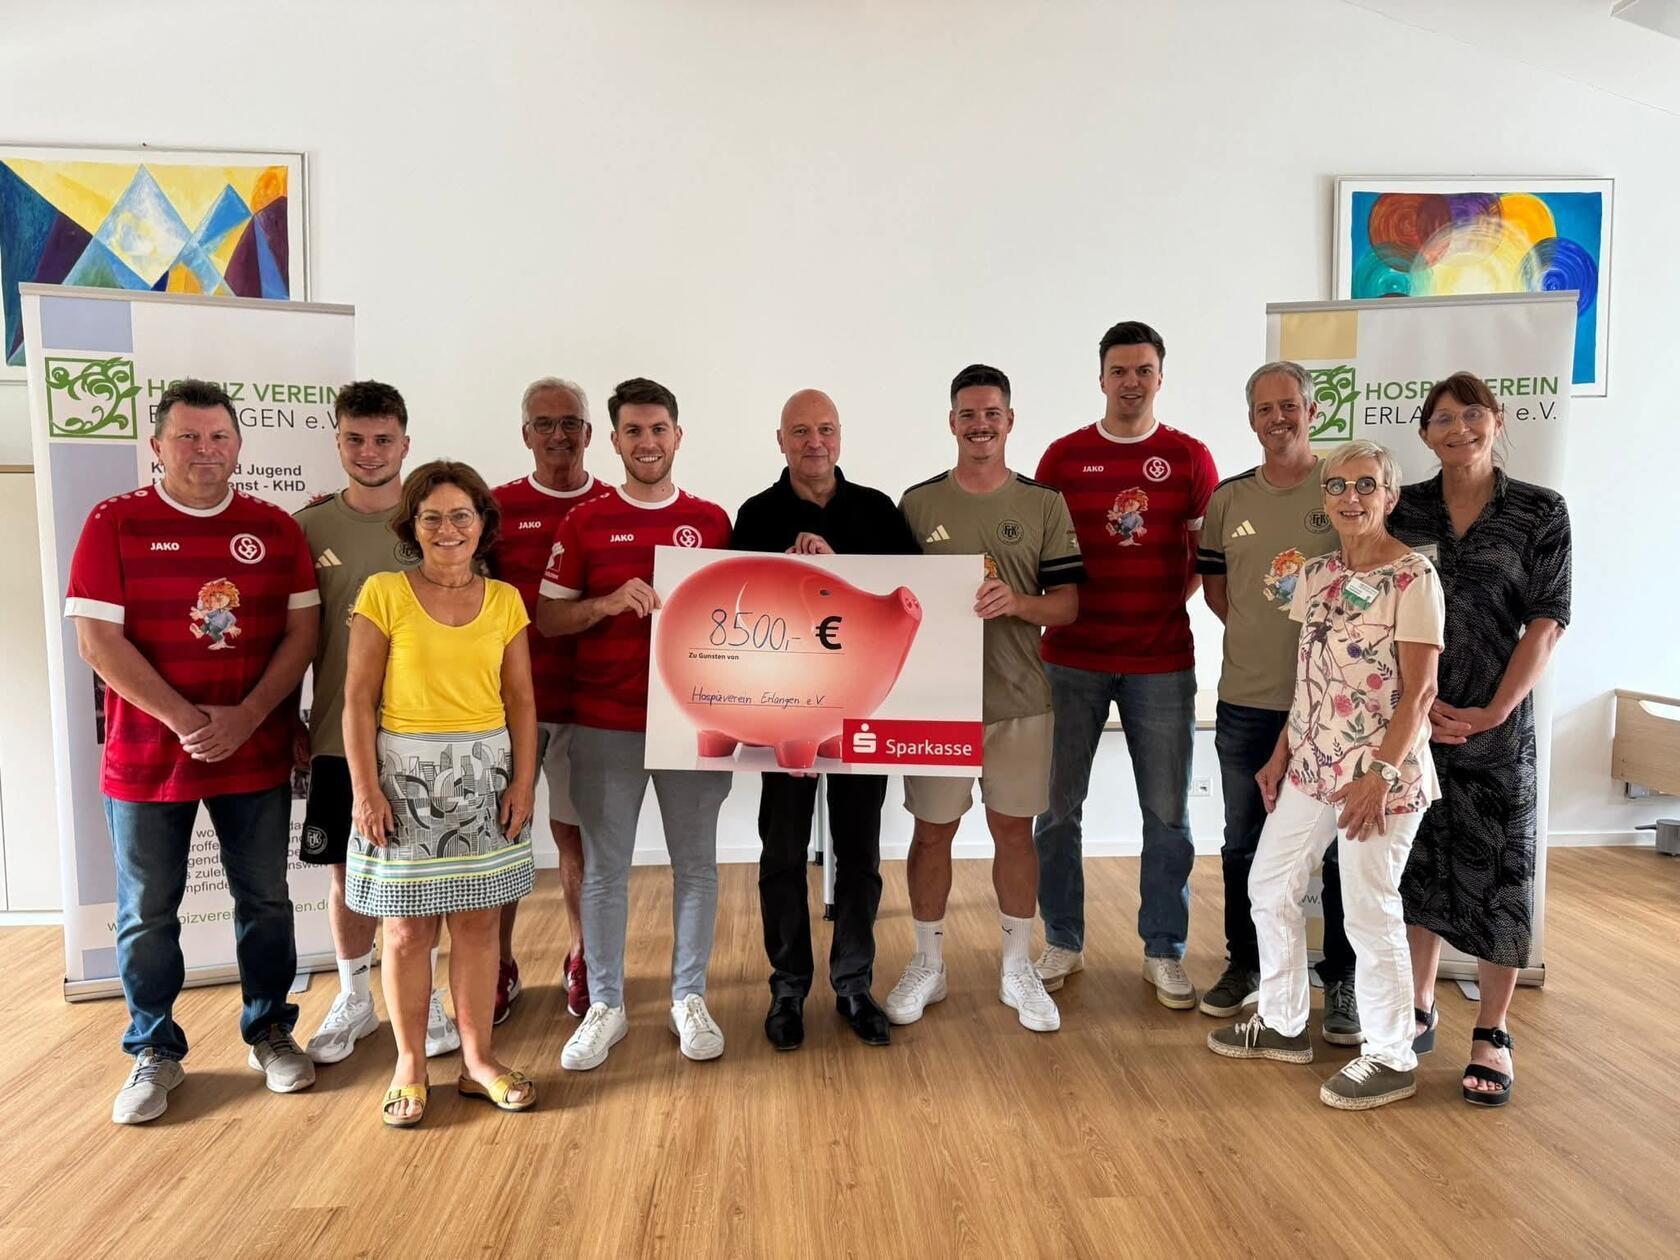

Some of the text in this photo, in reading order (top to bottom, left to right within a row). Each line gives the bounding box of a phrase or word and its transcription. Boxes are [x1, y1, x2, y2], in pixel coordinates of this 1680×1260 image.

[1366, 376, 1558, 401] HOSP EREIN
[1516, 401, 1557, 421] e.V.
[247, 464, 302, 478] Jugend
[273, 481, 305, 492] KHD
[518, 521, 542, 530] JAKO
[610, 533, 634, 542] JAKO
[150, 542, 180, 551] JAKO
[760, 691, 800, 709] Erlangen
[886, 739, 972, 757] Sparkasse
